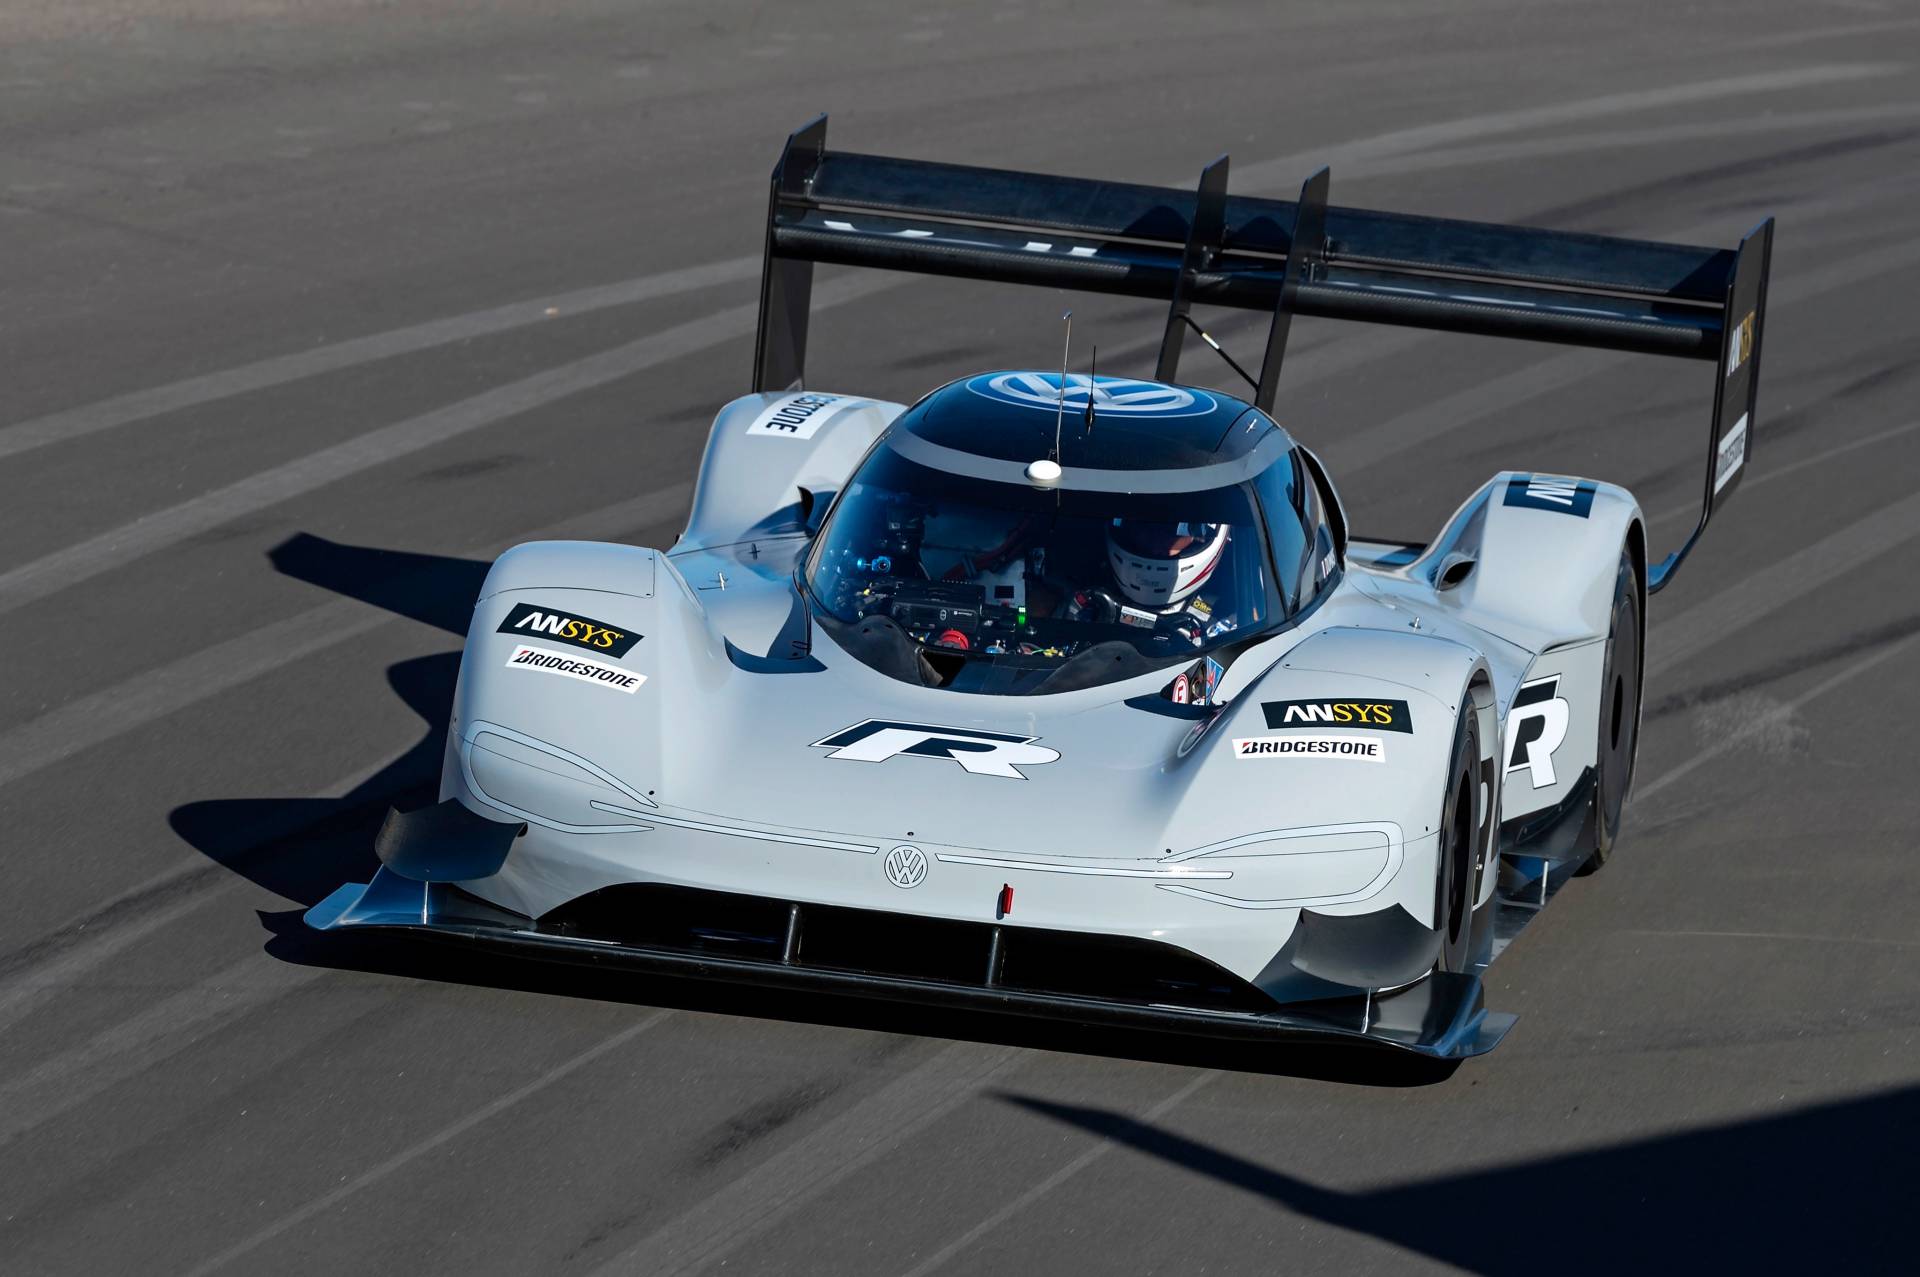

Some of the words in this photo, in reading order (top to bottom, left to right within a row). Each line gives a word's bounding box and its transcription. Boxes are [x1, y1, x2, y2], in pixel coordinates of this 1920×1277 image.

[514, 611, 620, 648] ANSYS
[513, 650, 638, 688] BRIDGESTONE
[1283, 703, 1393, 724] ANSYS
[808, 718, 1062, 780] R
[1242, 741, 1378, 756] BRIDGESTONE
[1503, 680, 1570, 790] R
[885, 845, 928, 889] VW
